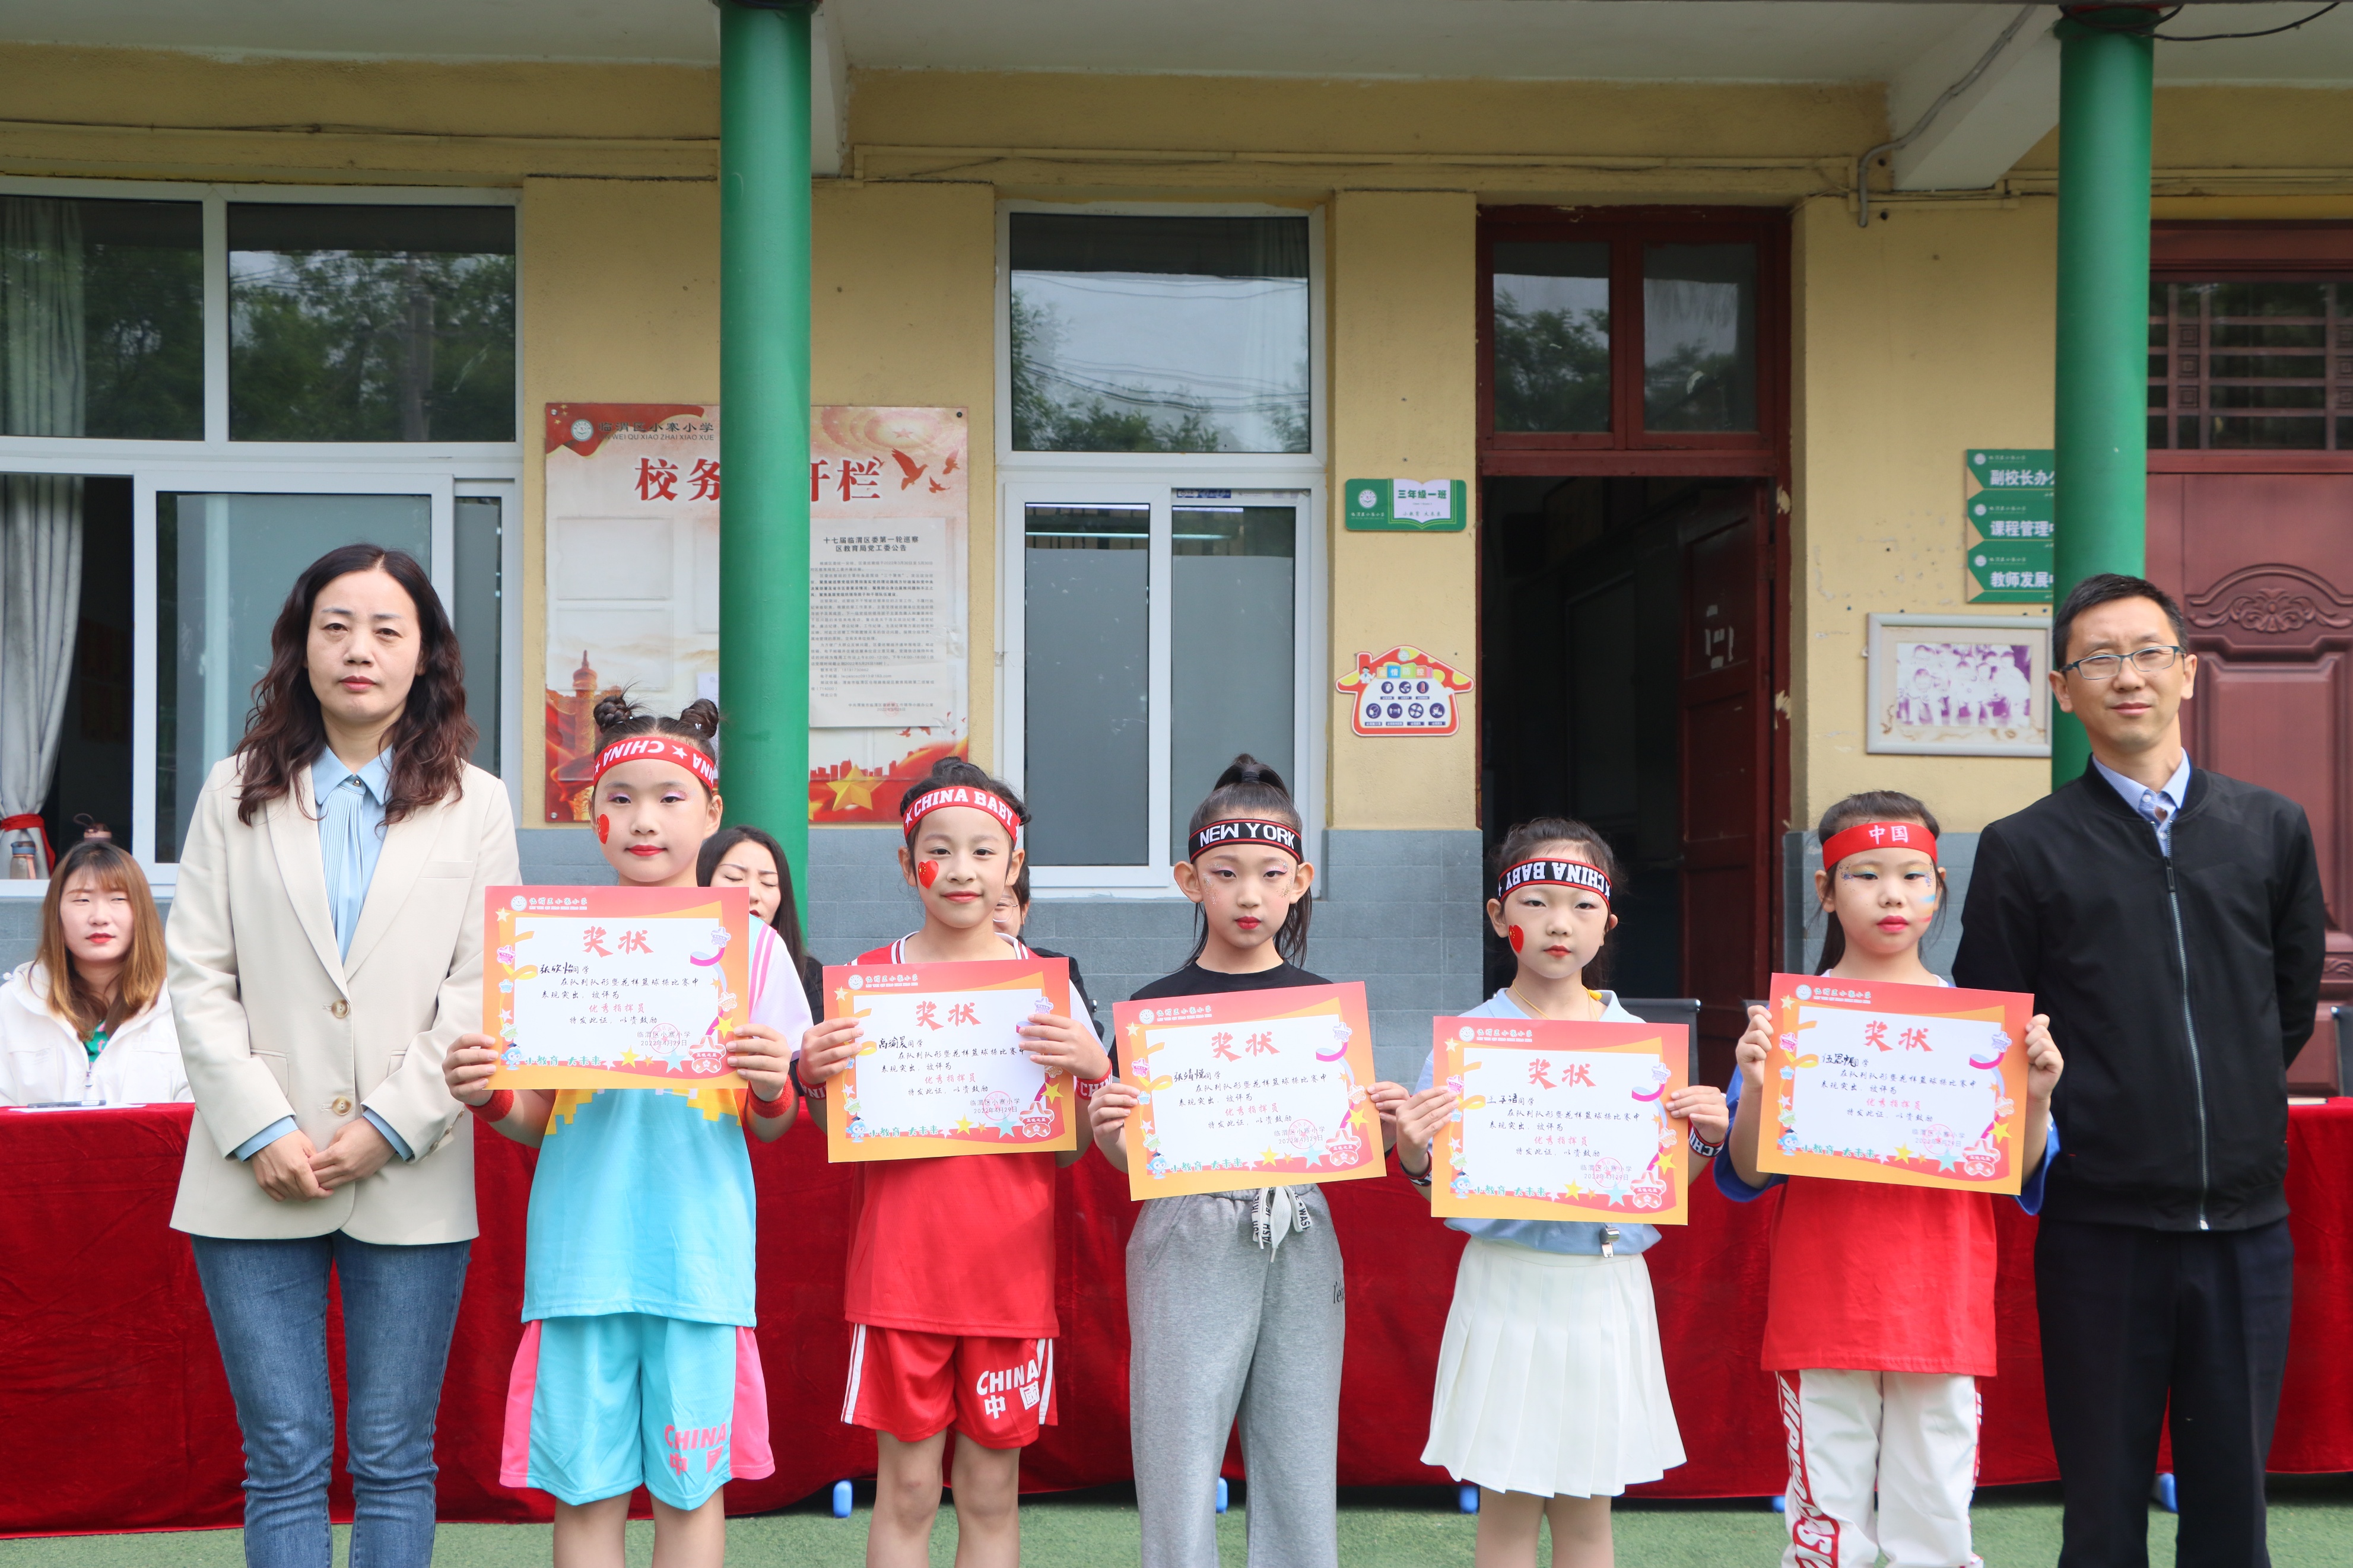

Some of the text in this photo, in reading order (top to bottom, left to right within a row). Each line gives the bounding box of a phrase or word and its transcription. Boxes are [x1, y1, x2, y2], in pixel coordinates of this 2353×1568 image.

[598, 422, 715, 432] 临渭区小寨小学
[1398, 489, 1447, 500] 三年级一班
[1990, 520, 2055, 537] 课程管理
[823, 536, 919, 544] 十七届临渭区委第一轮巡察
[1990, 571, 2054, 588] 教师发展
[602, 740, 665, 767] CHINA
[914, 788, 1013, 826] CHINA BABY
[1199, 822, 1295, 850] NEW YORK
[1868, 825, 1909, 845] 中国
[1506, 861, 1606, 893] CHINA BABY
[582, 925, 654, 958] 奖状
[589, 1003, 645, 1014] 优秀指挥员
[916, 1000, 982, 1031] 奖状
[1862, 1020, 1934, 1052] 奖状
[1211, 1031, 1280, 1062] 奖状
[525, 1054, 602, 1066] 小教育 大未来
[925, 1073, 976, 1084] 优秀指挥员
[1528, 1058, 1597, 1090] 奖状
[970, 1098, 1020, 1106] 临渭区小寨小学
[1225, 1102, 1279, 1117] 优秀指挥员
[1866, 1098, 1921, 1111] 优秀指挥员
[869, 1125, 939, 1138] 小教育 大未来
[1534, 1135, 1588, 1147] 优秀指挥员
[1802, 1143, 1875, 1159] 小教育 大未来
[1170, 1157, 1243, 1173] 小教育 大未来
[1474, 1184, 1548, 1197] 小教育 大未来
[976, 1359, 1040, 1395] CHINA
[664, 1422, 727, 1451] CHINA
